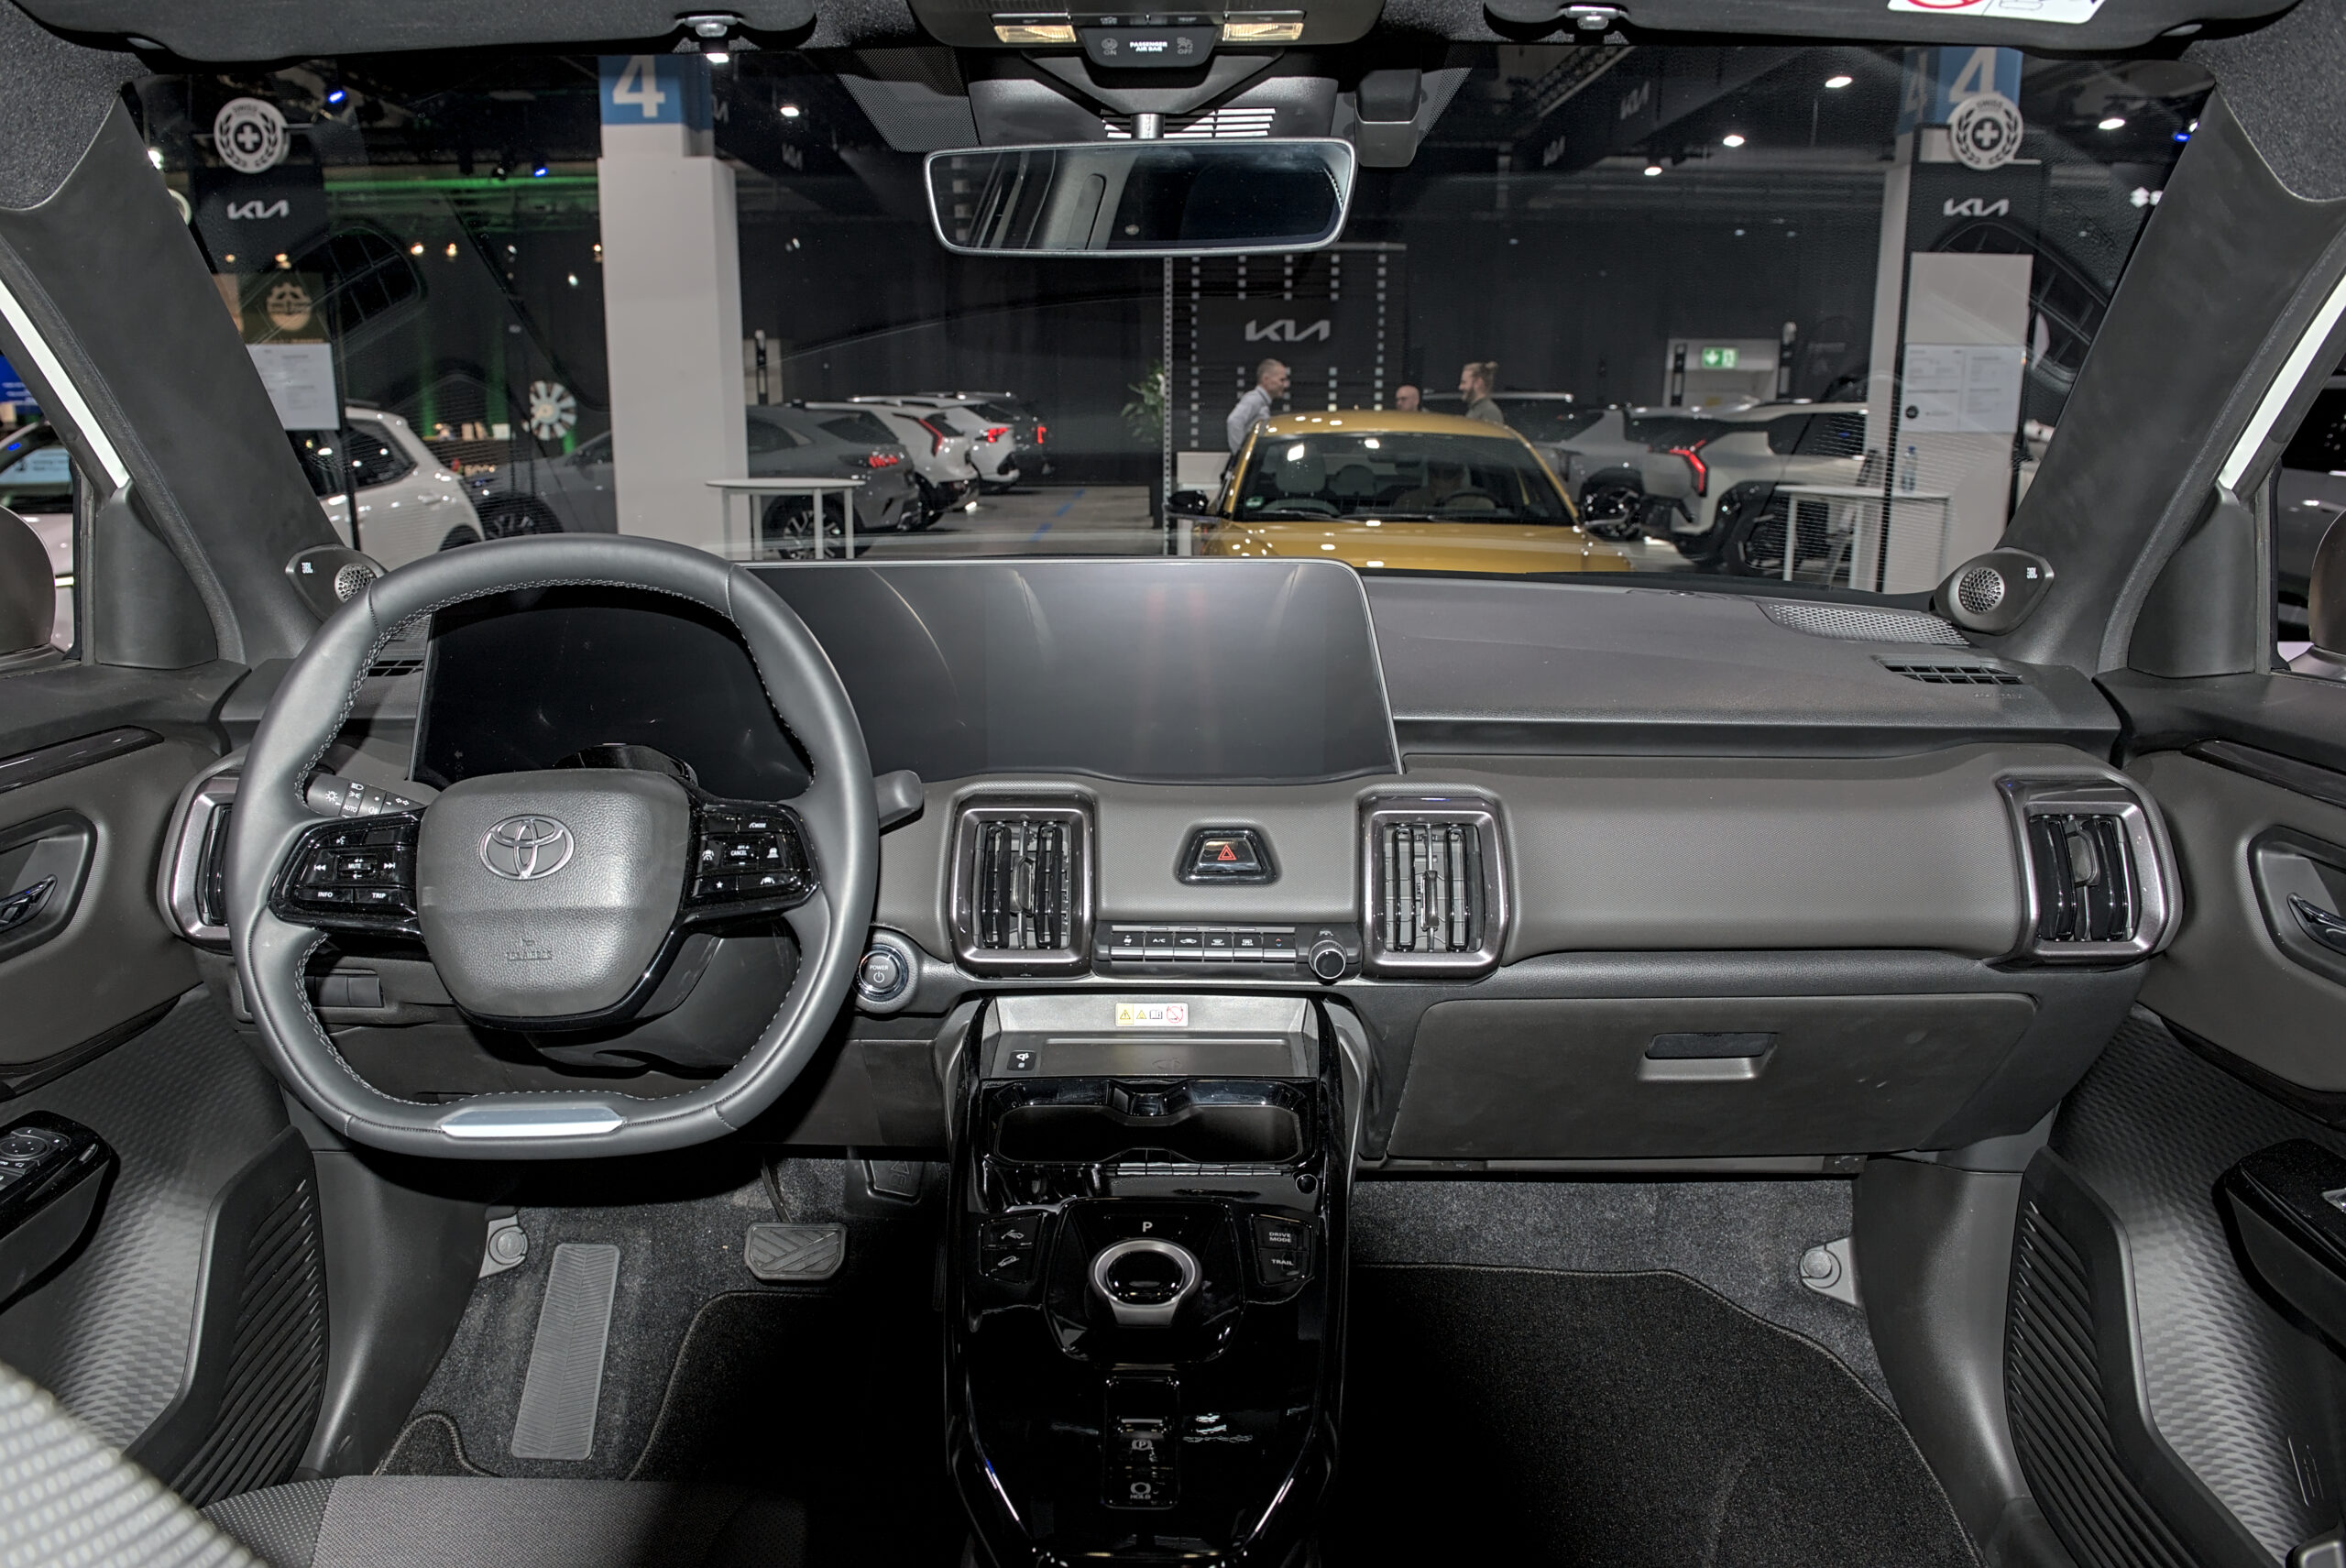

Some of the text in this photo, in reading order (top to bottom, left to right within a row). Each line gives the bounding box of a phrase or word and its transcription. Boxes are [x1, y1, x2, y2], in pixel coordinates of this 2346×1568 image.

[1948, 48, 2001, 104] 4
[613, 55, 666, 118] 4
[227, 199, 290, 221] KIA
[1943, 197, 2010, 216] KIA
[1244, 318, 1331, 342] KIA
[2026, 566, 2038, 579] JBL
[343, 804, 358, 813] AUTO
[1142, 1221, 1153, 1233] P
[1271, 1258, 1294, 1266] TRAIL
